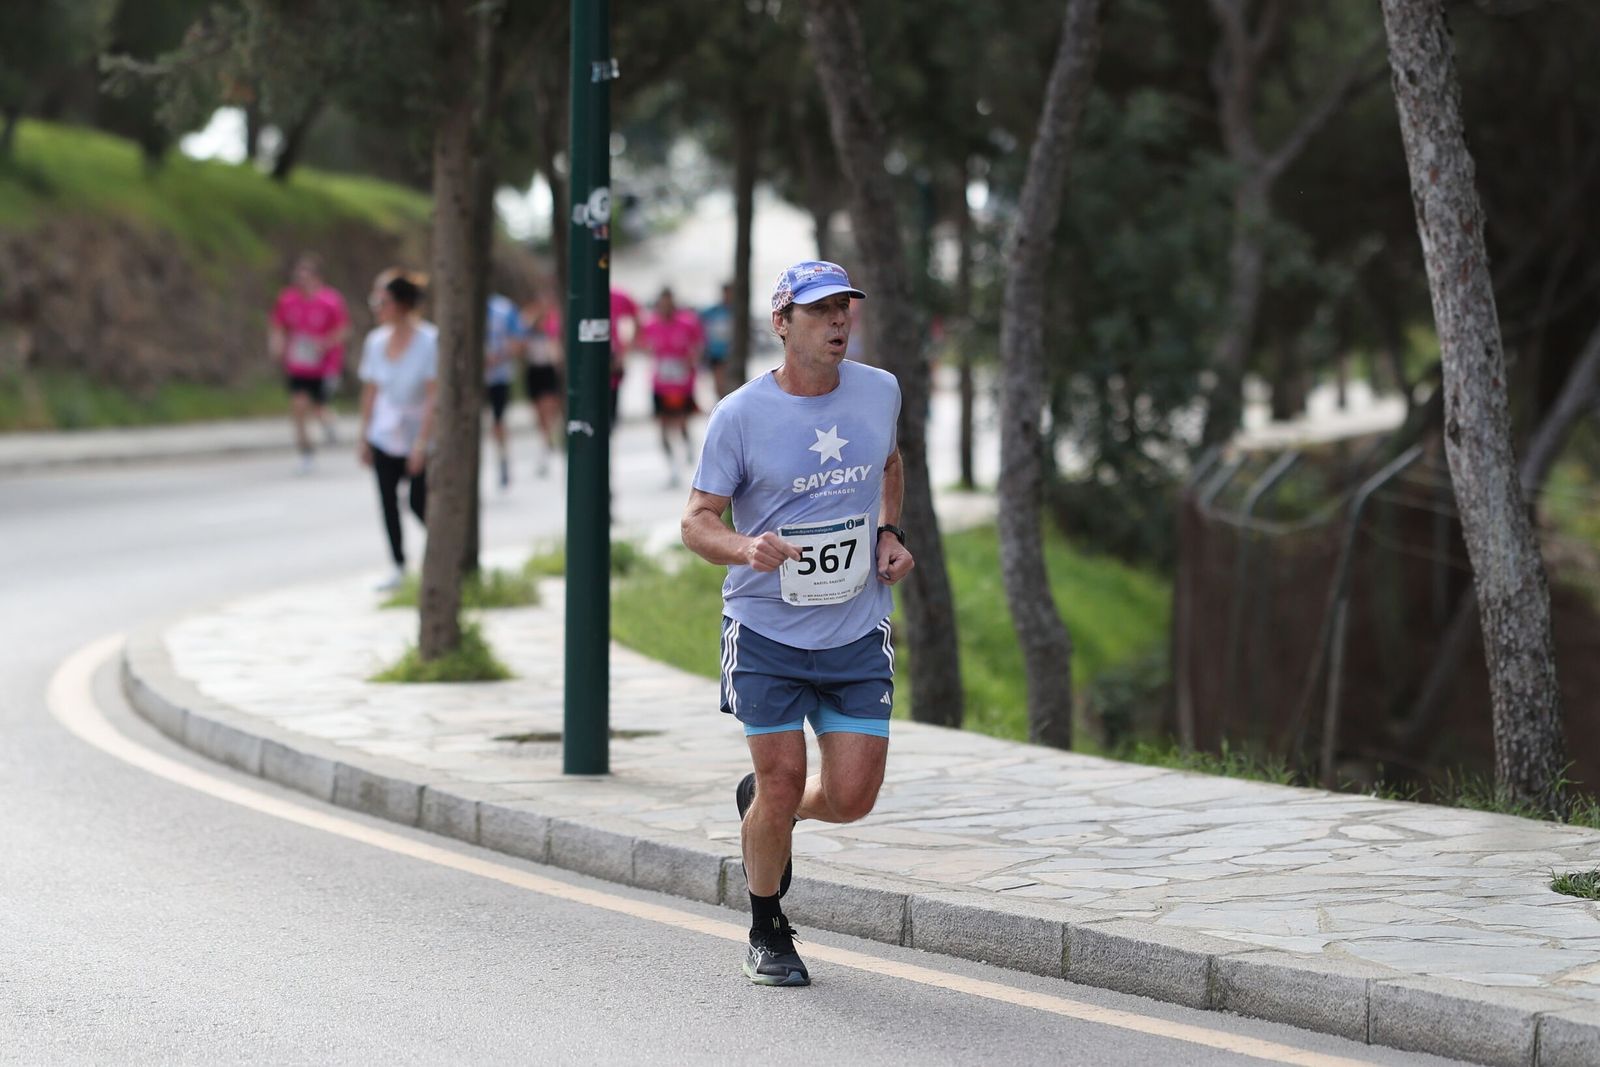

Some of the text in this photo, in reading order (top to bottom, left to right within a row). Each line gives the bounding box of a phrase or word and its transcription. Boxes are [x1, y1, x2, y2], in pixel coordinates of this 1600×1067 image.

[792, 464, 873, 493] SAYSKY
[809, 487, 856, 499] COPENHAGEN
[797, 538, 857, 576] 567
